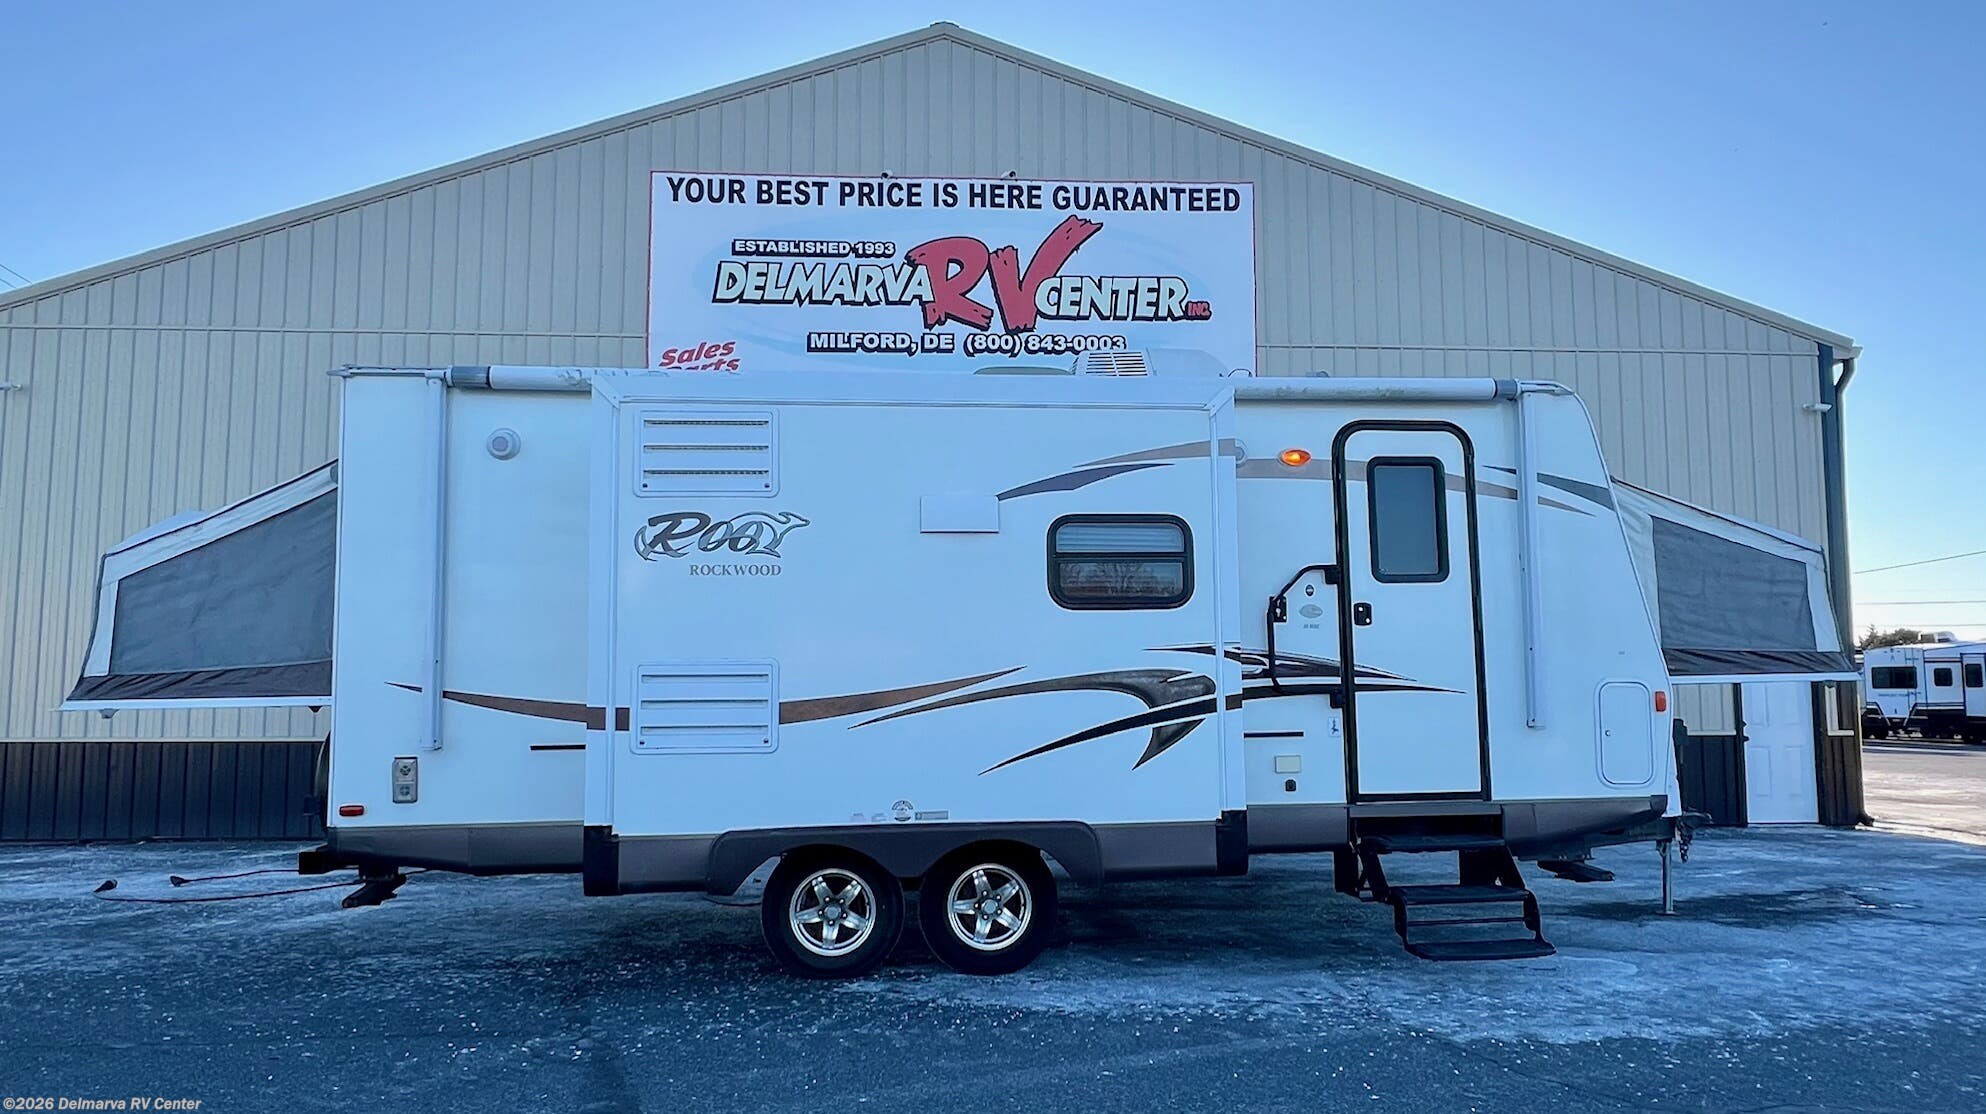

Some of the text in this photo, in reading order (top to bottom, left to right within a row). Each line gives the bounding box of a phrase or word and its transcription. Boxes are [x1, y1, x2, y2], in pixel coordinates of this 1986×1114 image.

[667, 177, 1241, 212] YOUR BEST PRICE IS HERE GUARANTEED
[733, 240, 896, 256] ESTABLISHED 1993
[713, 261, 935, 306] DELMARVA
[905, 215, 1104, 333] RV
[1035, 276, 1188, 320] CENTER
[658, 341, 736, 366] Sales
[808, 332, 1126, 356] MILFORD, DE (800) 843-0003
[690, 564, 782, 576] ROCKWOOD
